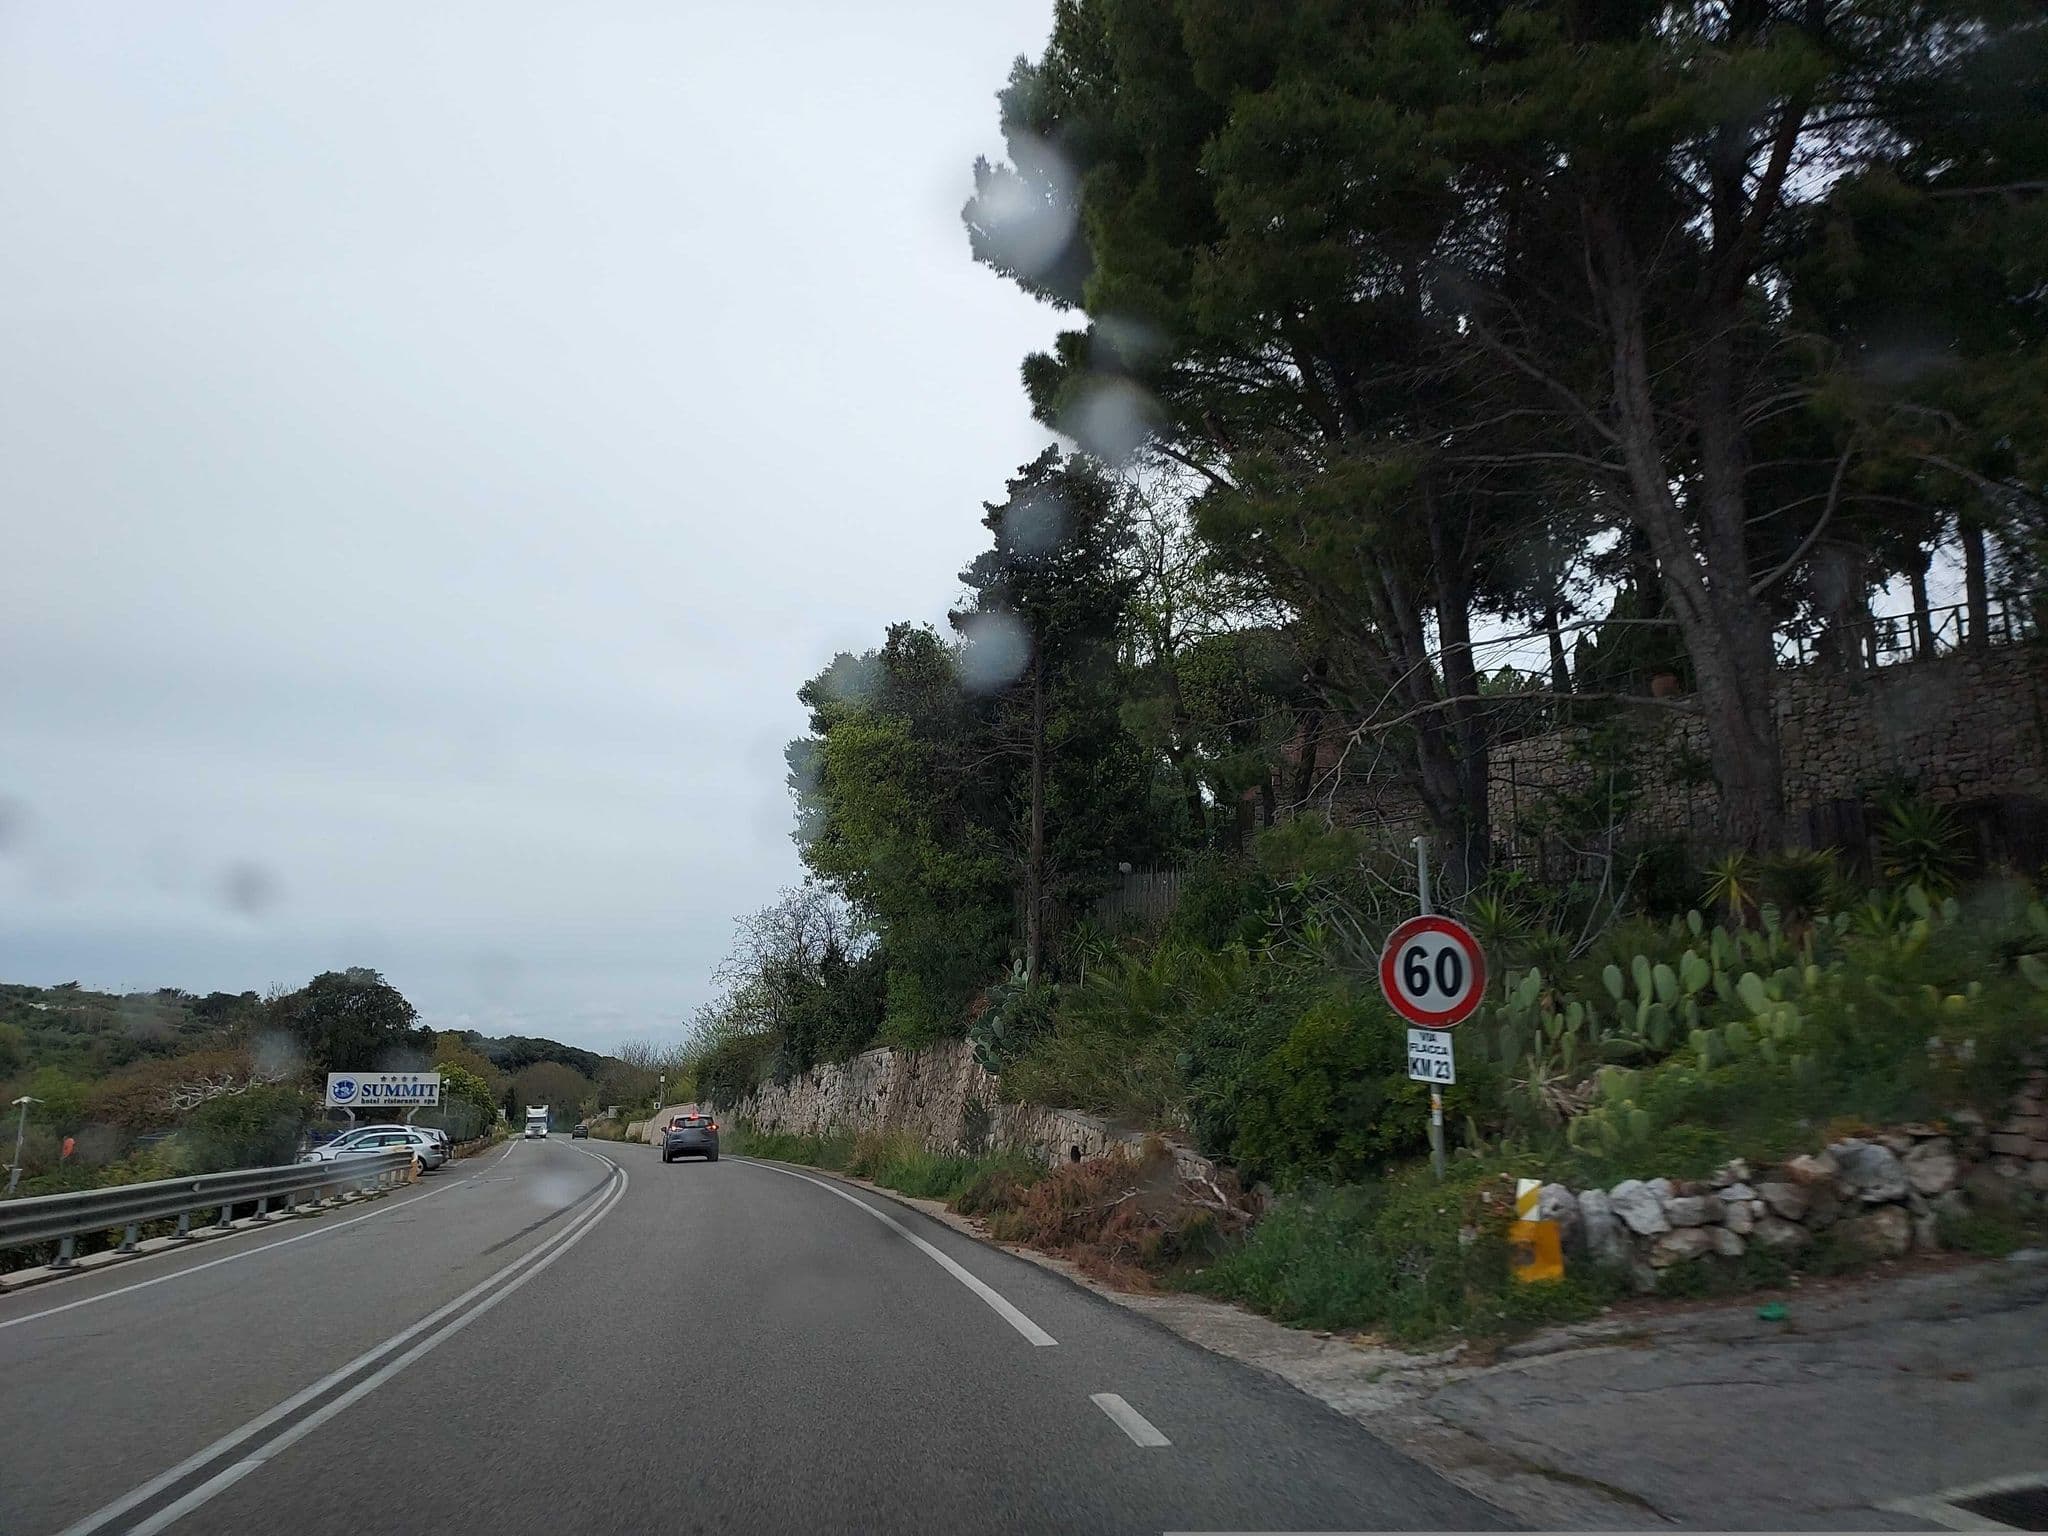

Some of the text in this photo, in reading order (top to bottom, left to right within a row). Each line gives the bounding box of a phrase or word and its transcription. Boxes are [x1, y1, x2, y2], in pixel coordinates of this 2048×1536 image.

[1404, 945, 1462, 997] 60
[1419, 1032, 1437, 1042] VIA
[1409, 1042, 1448, 1055] FLACCA
[1409, 1057, 1450, 1080] KM 23
[361, 1083, 438, 1097] SUMMIT
